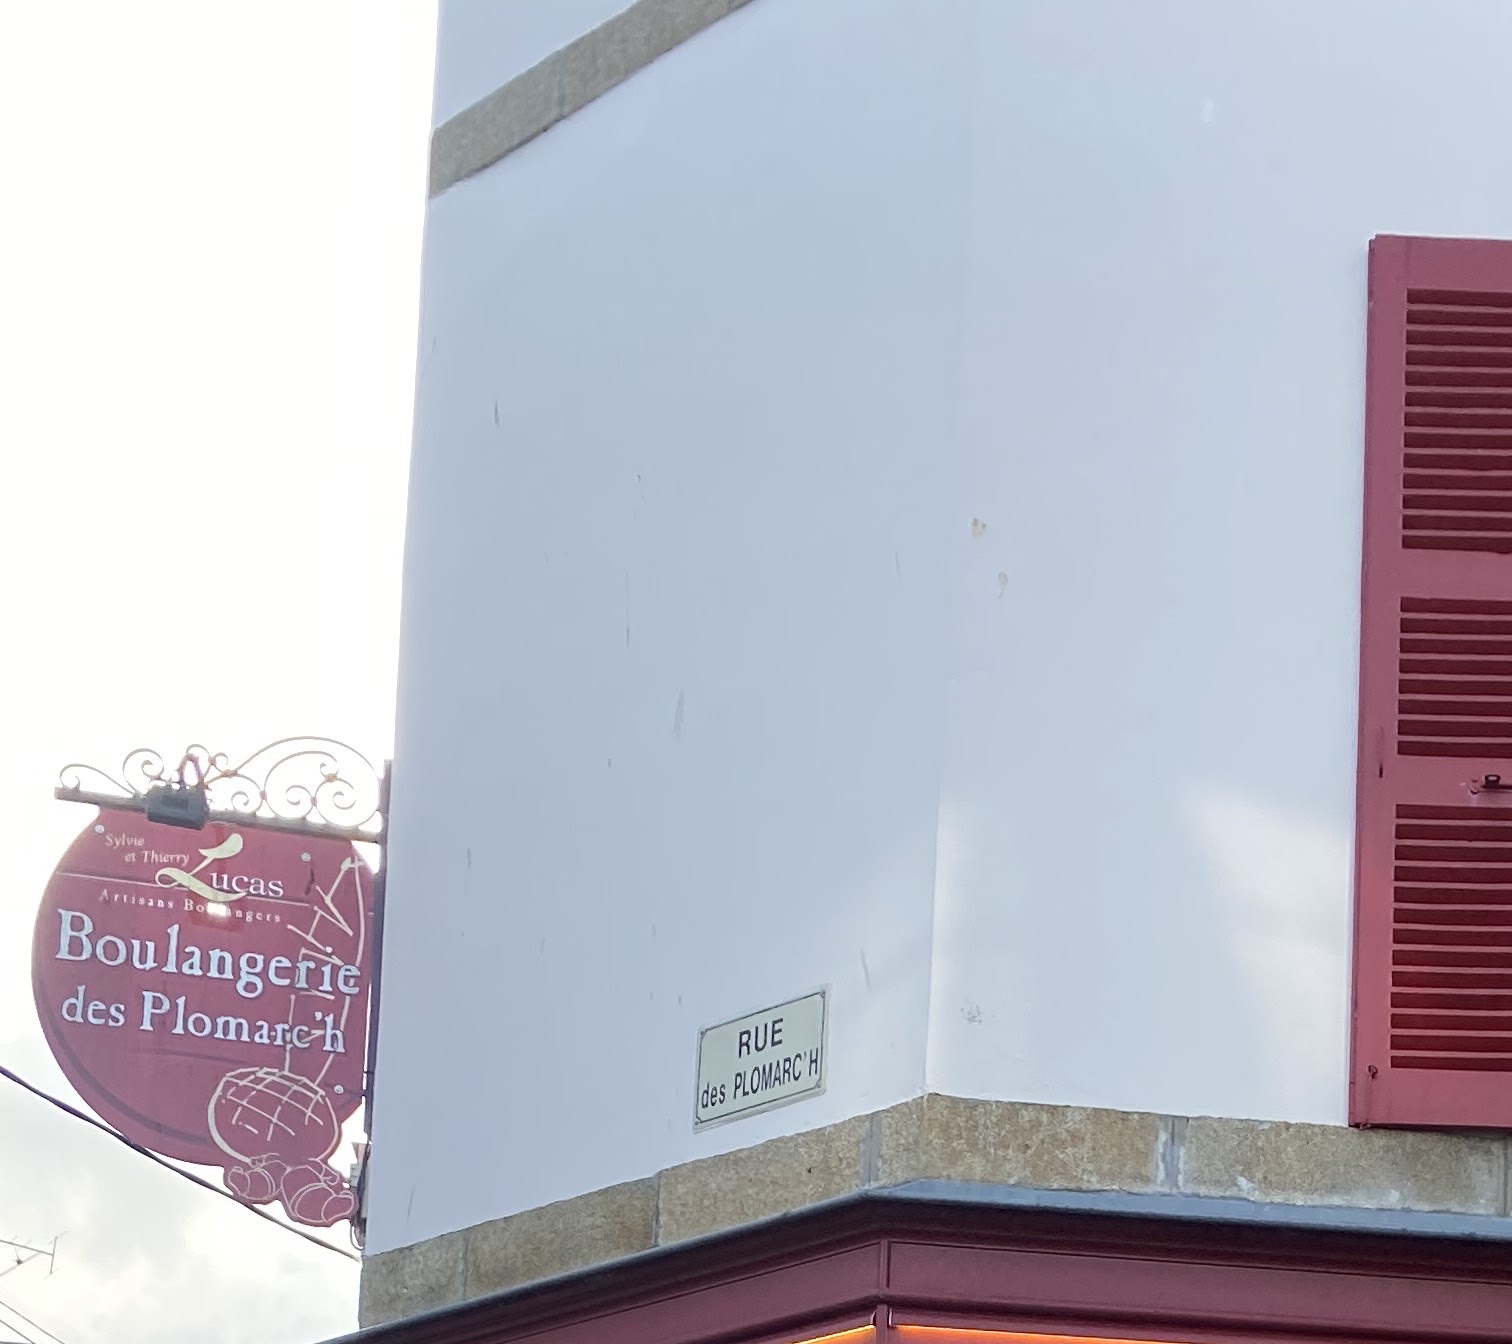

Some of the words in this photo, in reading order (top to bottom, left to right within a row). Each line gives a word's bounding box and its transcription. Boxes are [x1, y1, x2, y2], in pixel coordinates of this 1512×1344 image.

[105, 833, 145, 848] Sylvie
[124, 853, 136, 863] et
[142, 850, 190, 867] Thierry
[154, 833, 285, 903] Lucas
[98, 888, 174, 909] Artisans
[54, 908, 362, 998] Boulangerie
[59, 985, 127, 1027] des
[138, 991, 346, 1054] Plomarc'h
[738, 1018, 784, 1058] RUE
[701, 1082, 726, 1109] des
[733, 1048, 819, 1099] PLOMARC'H
